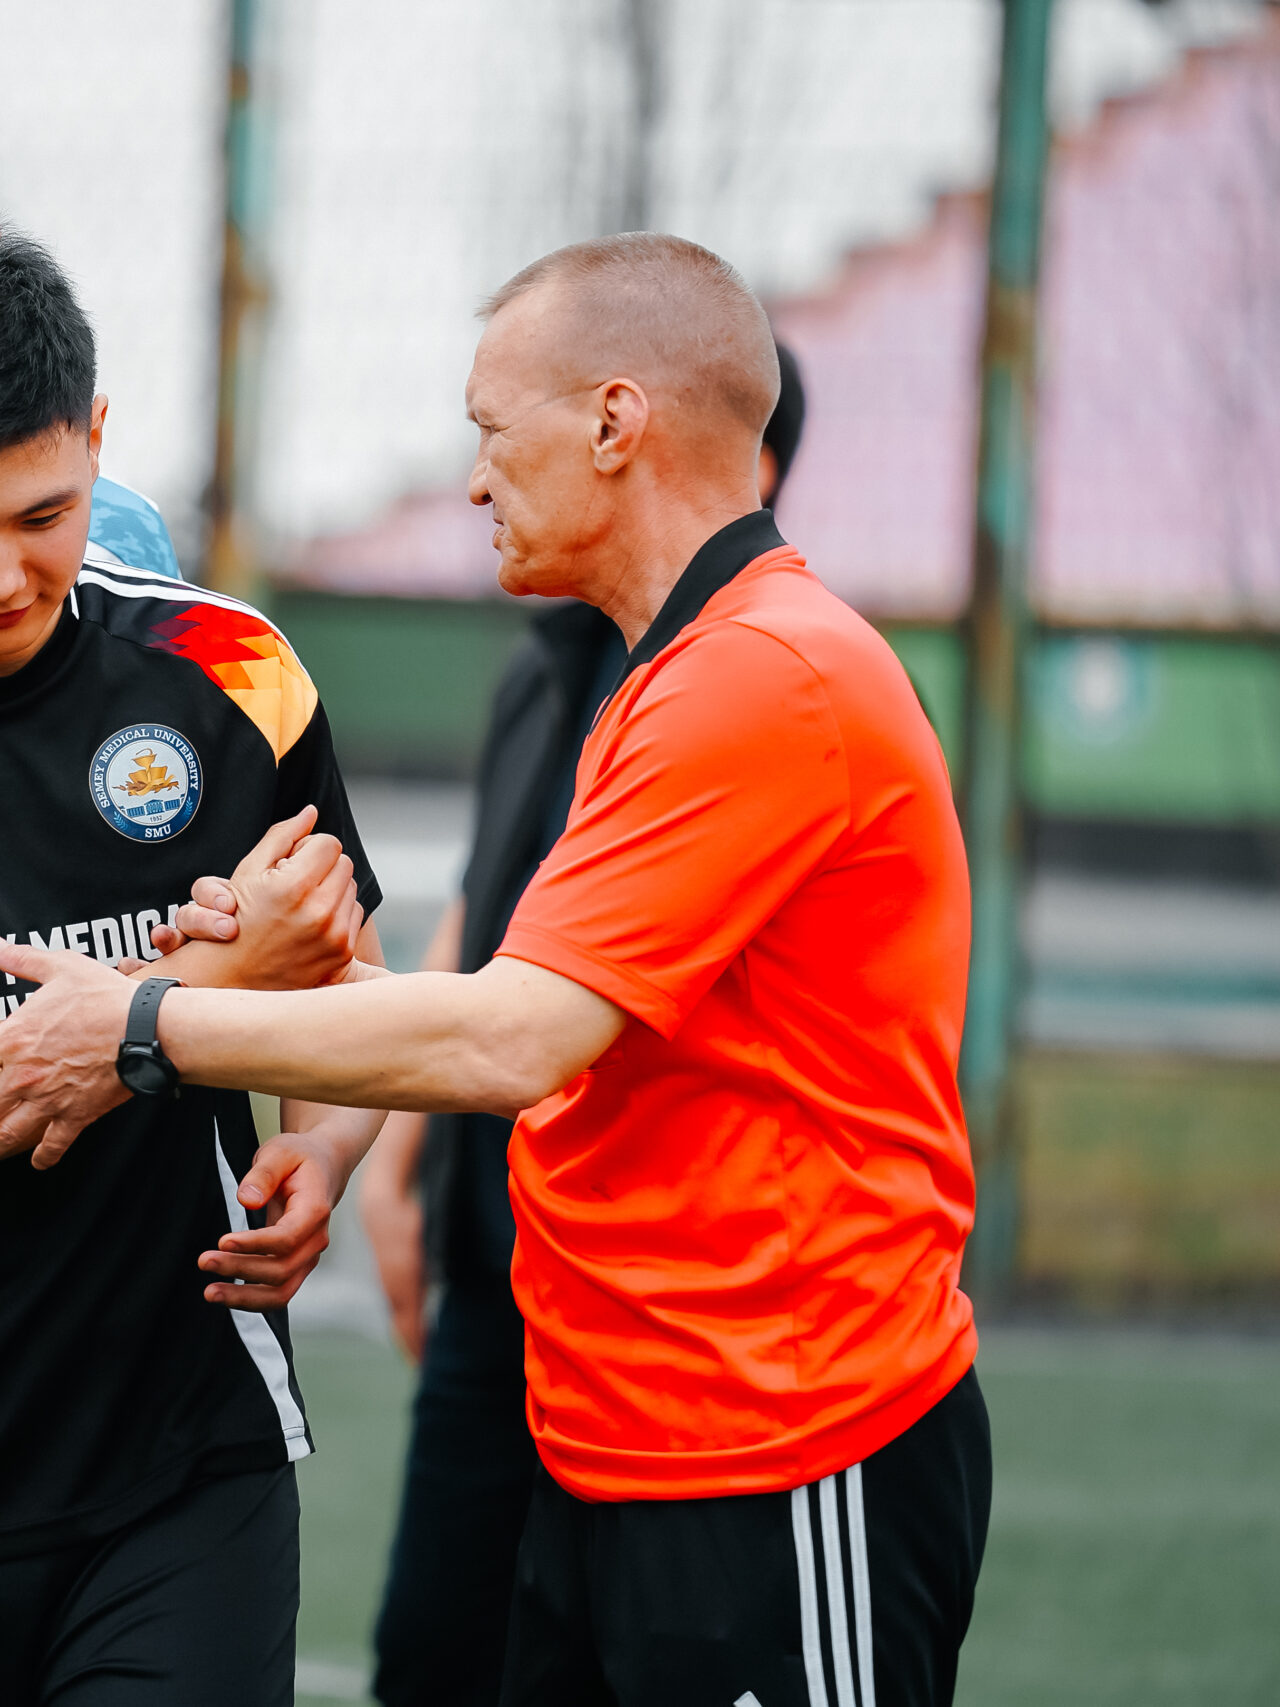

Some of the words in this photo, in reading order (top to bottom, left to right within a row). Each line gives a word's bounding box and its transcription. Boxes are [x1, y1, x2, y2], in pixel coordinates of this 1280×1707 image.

[99, 728, 150, 764] MEDICAL
[153, 728, 199, 791] UNIVERSITY
[94, 764, 110, 808] SEMEY
[145, 824, 171, 838] SMU
